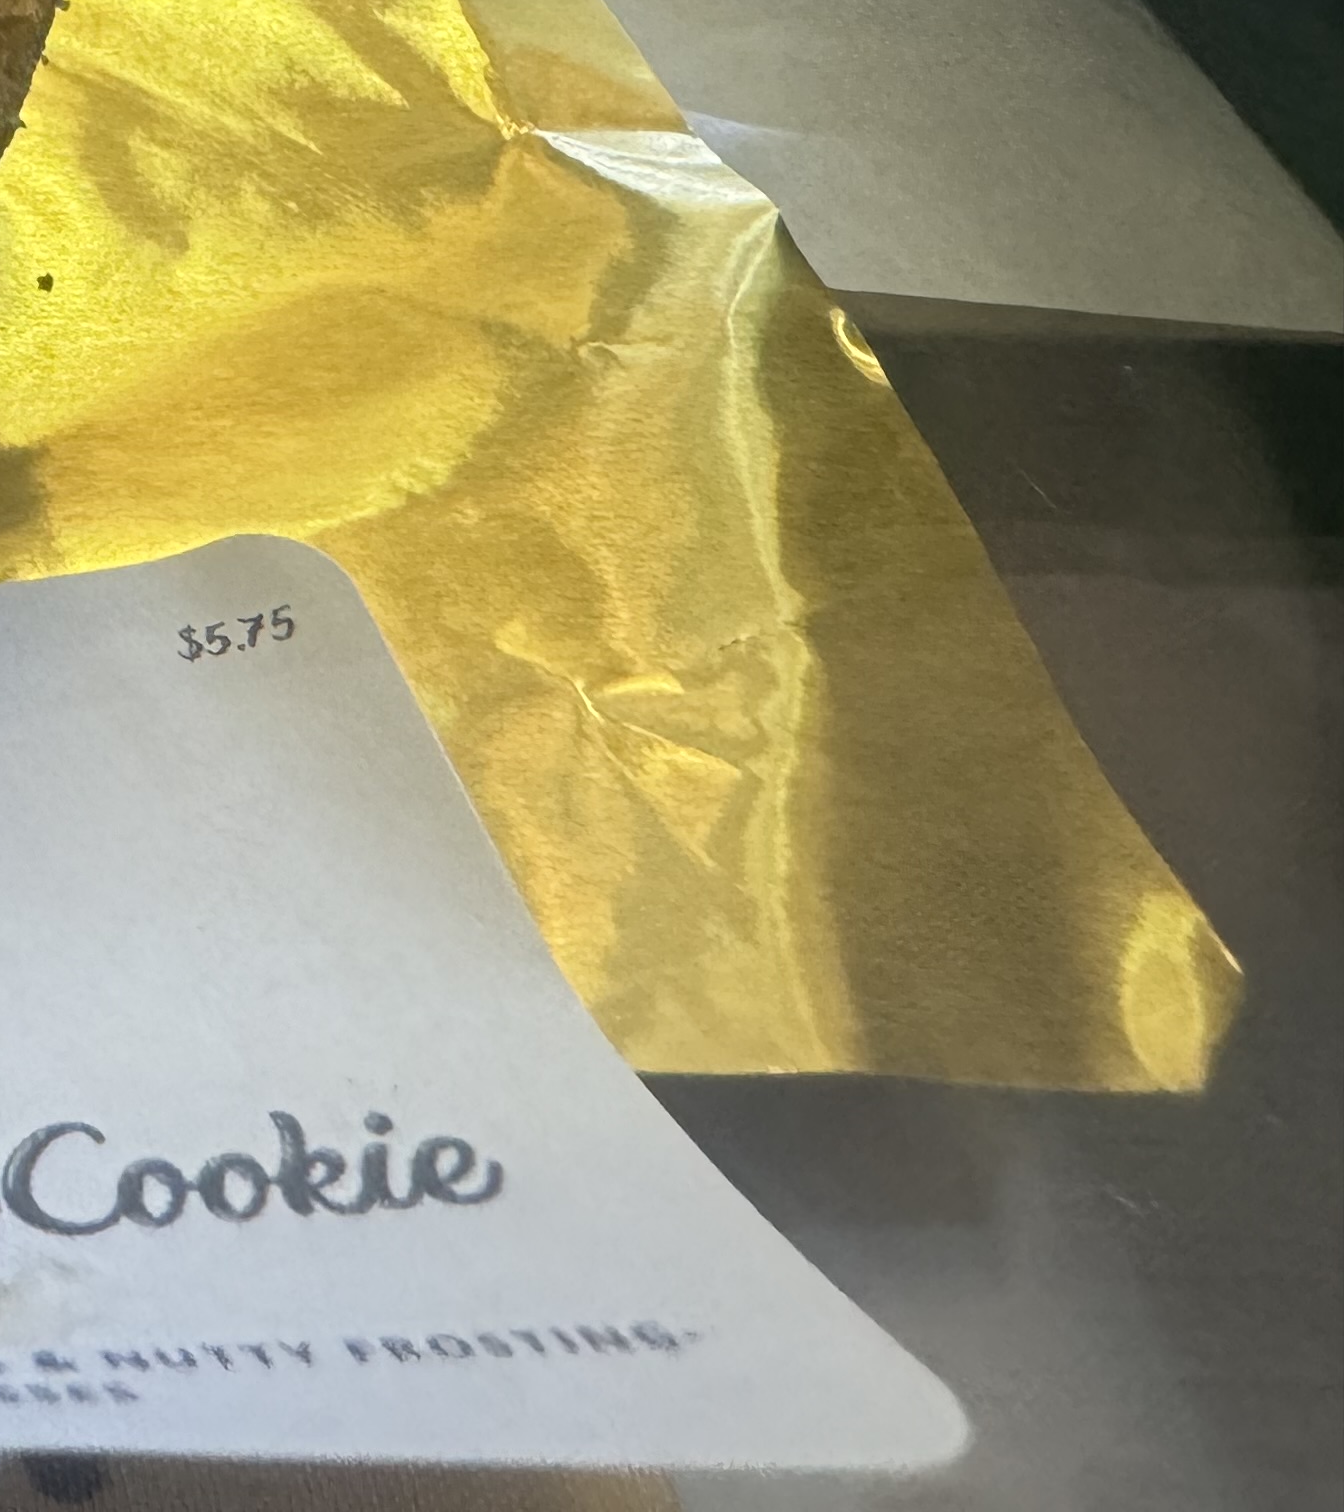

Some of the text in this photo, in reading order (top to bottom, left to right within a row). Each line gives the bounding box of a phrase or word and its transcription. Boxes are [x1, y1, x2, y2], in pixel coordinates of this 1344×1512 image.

[177, 604, 296, 663] $5.75
[0, 1108, 507, 1236] Cookie
[100, 1339, 315, 1372] NUTTY
